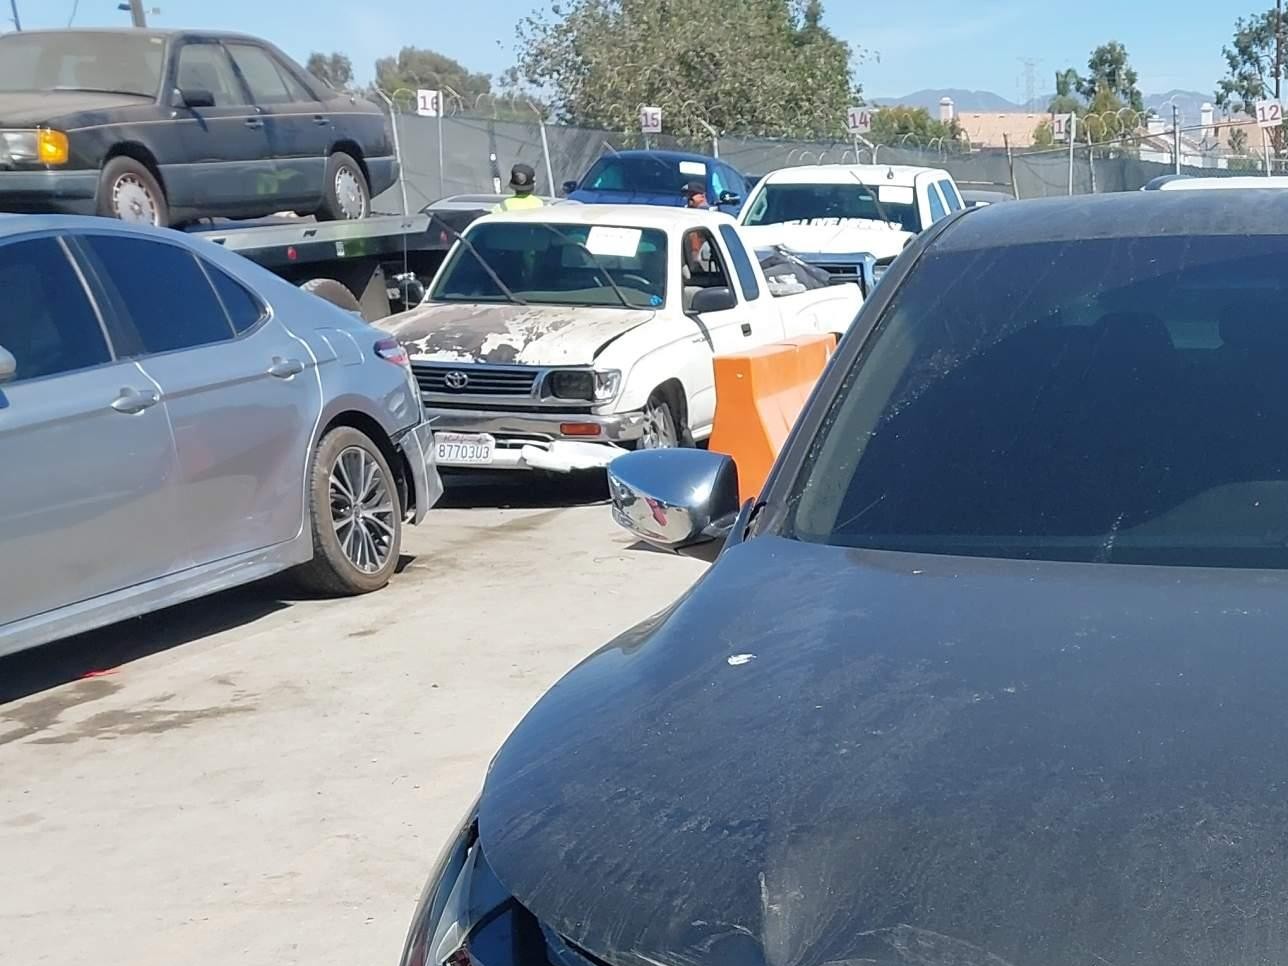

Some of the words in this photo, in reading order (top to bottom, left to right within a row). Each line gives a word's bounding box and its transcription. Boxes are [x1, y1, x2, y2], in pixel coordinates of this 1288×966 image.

[643, 111, 659, 128] 15
[850, 111, 869, 128] 14
[1259, 104, 1281, 122] 12
[438, 444, 490, 459] 87703U3
